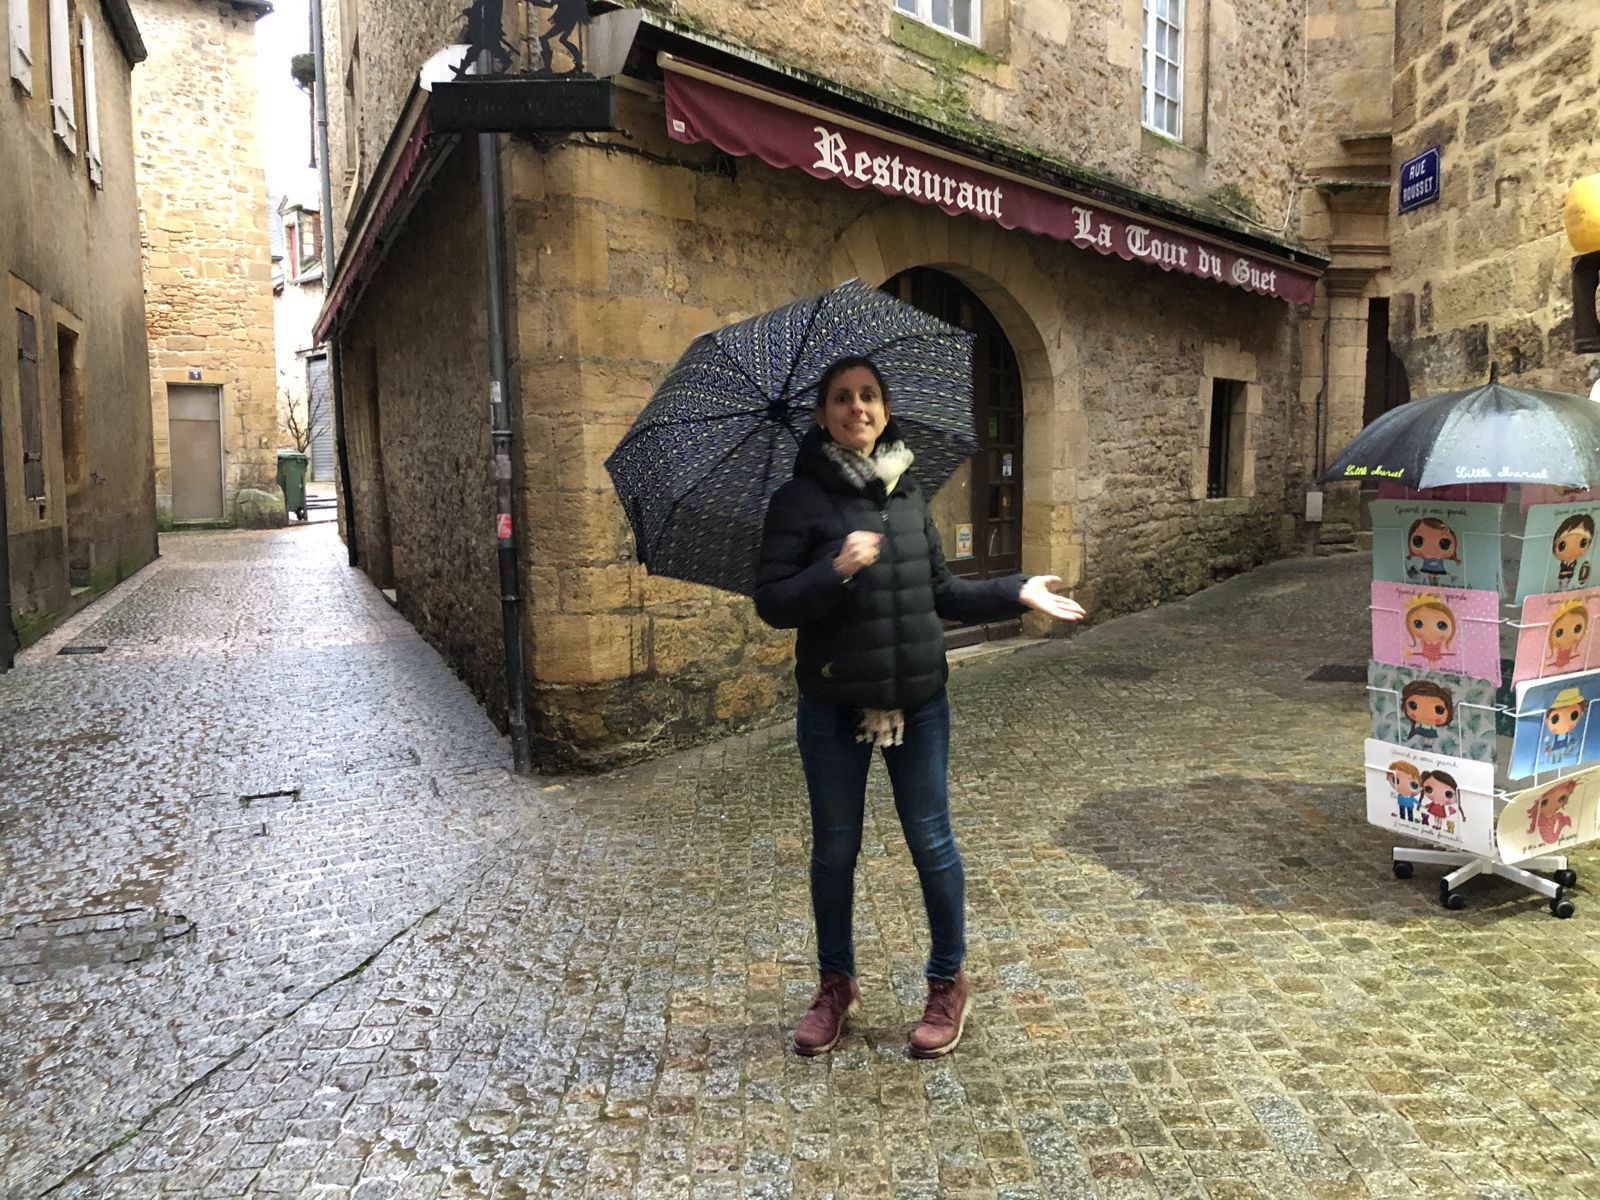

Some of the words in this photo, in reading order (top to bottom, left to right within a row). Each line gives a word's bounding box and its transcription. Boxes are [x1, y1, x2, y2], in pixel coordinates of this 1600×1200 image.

[812, 126, 1003, 219] Restaurant
[1409, 159, 1426, 180] RUE
[1403, 176, 1433, 202] ROUSSET
[1072, 206, 1112, 248] La
[1126, 225, 1188, 267] Tour
[1232, 258, 1277, 293] Guet
[1344, 464, 1368, 476] Little
[1370, 465, 1405, 478] Marcel
[1455, 466, 1491, 478] Little
[1497, 466, 1549, 479] Marcel
